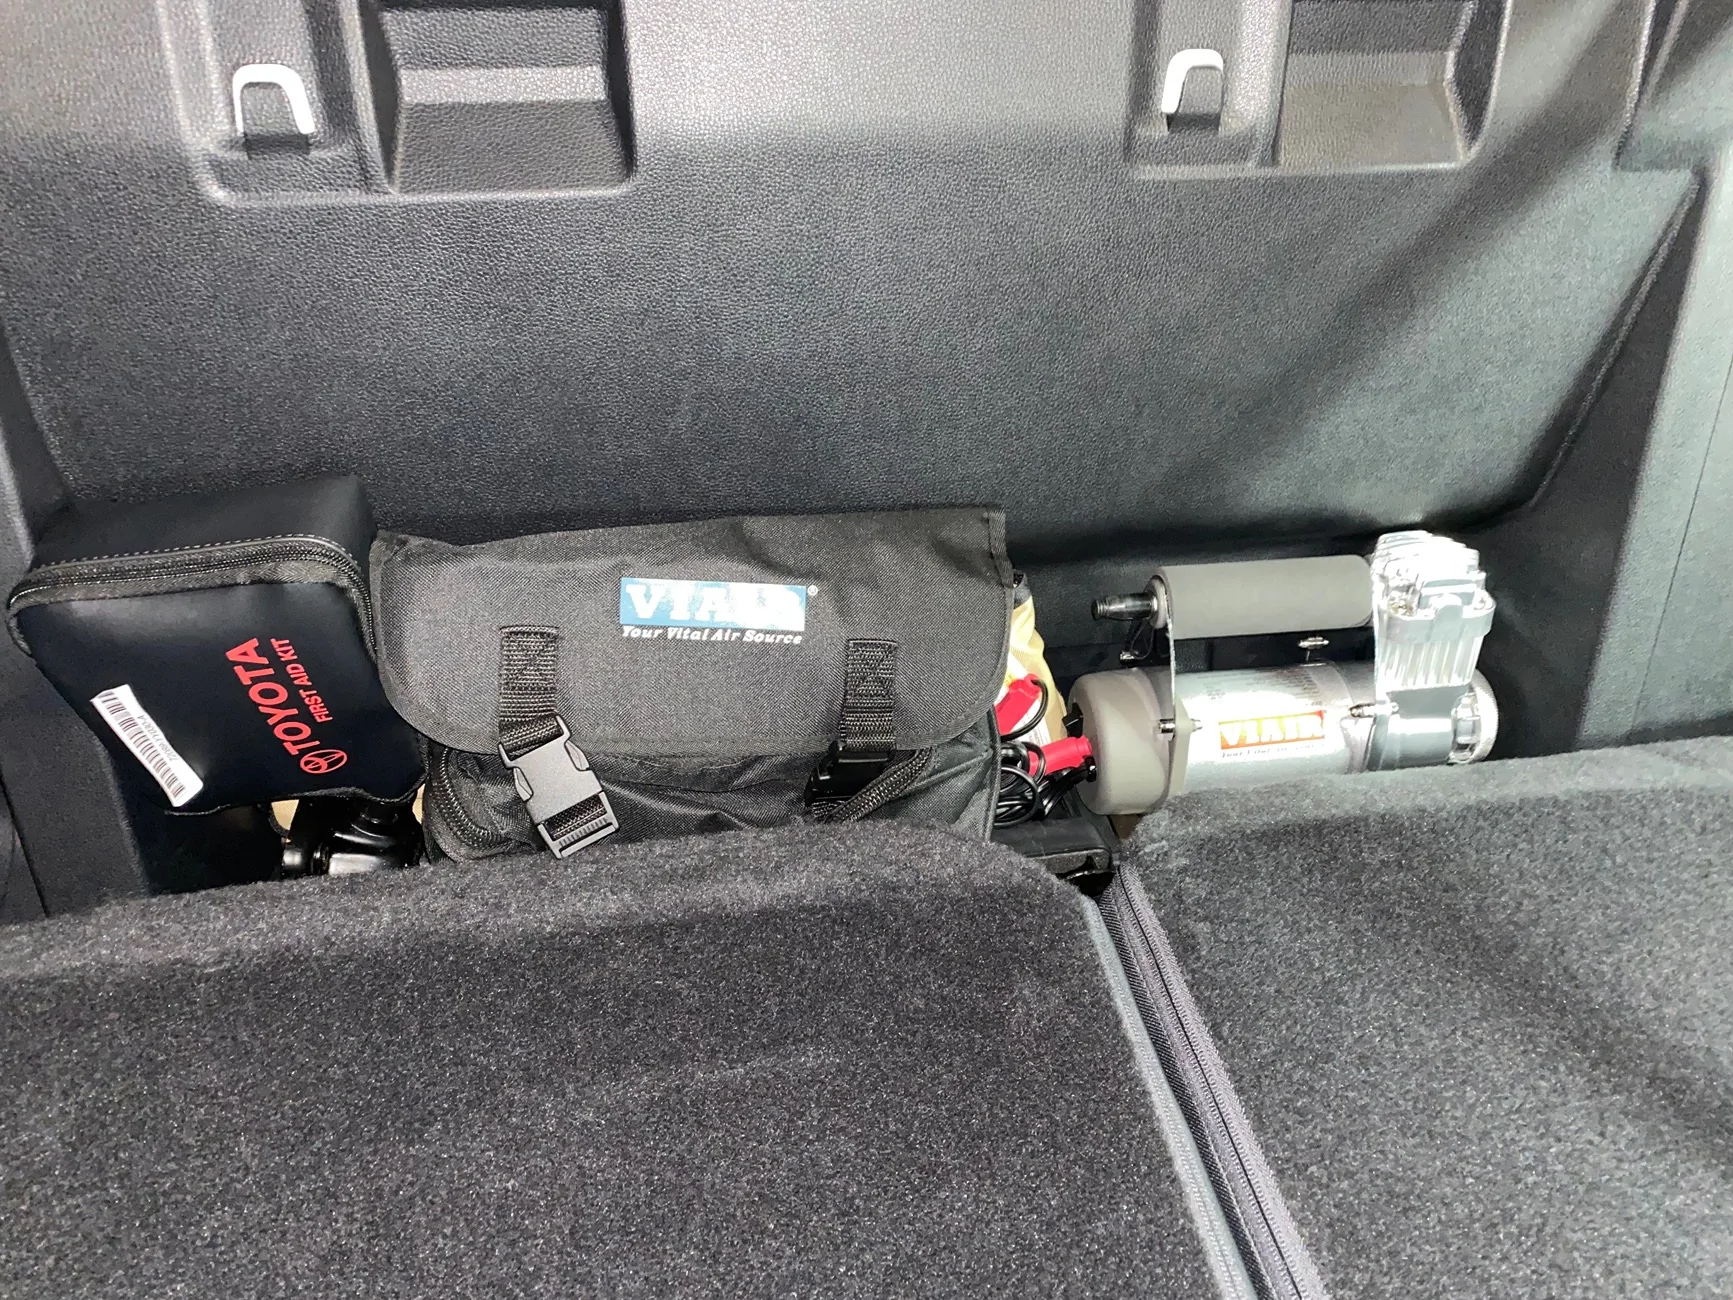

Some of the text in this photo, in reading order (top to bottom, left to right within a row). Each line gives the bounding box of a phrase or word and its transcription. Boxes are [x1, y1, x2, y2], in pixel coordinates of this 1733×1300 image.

[622, 625, 803, 645] Your Vital Air Source
[225, 637, 320, 756] TOYOTA
[270, 638, 333, 723] FIRST AID KIT
[1218, 714, 1325, 746] VIAIR
